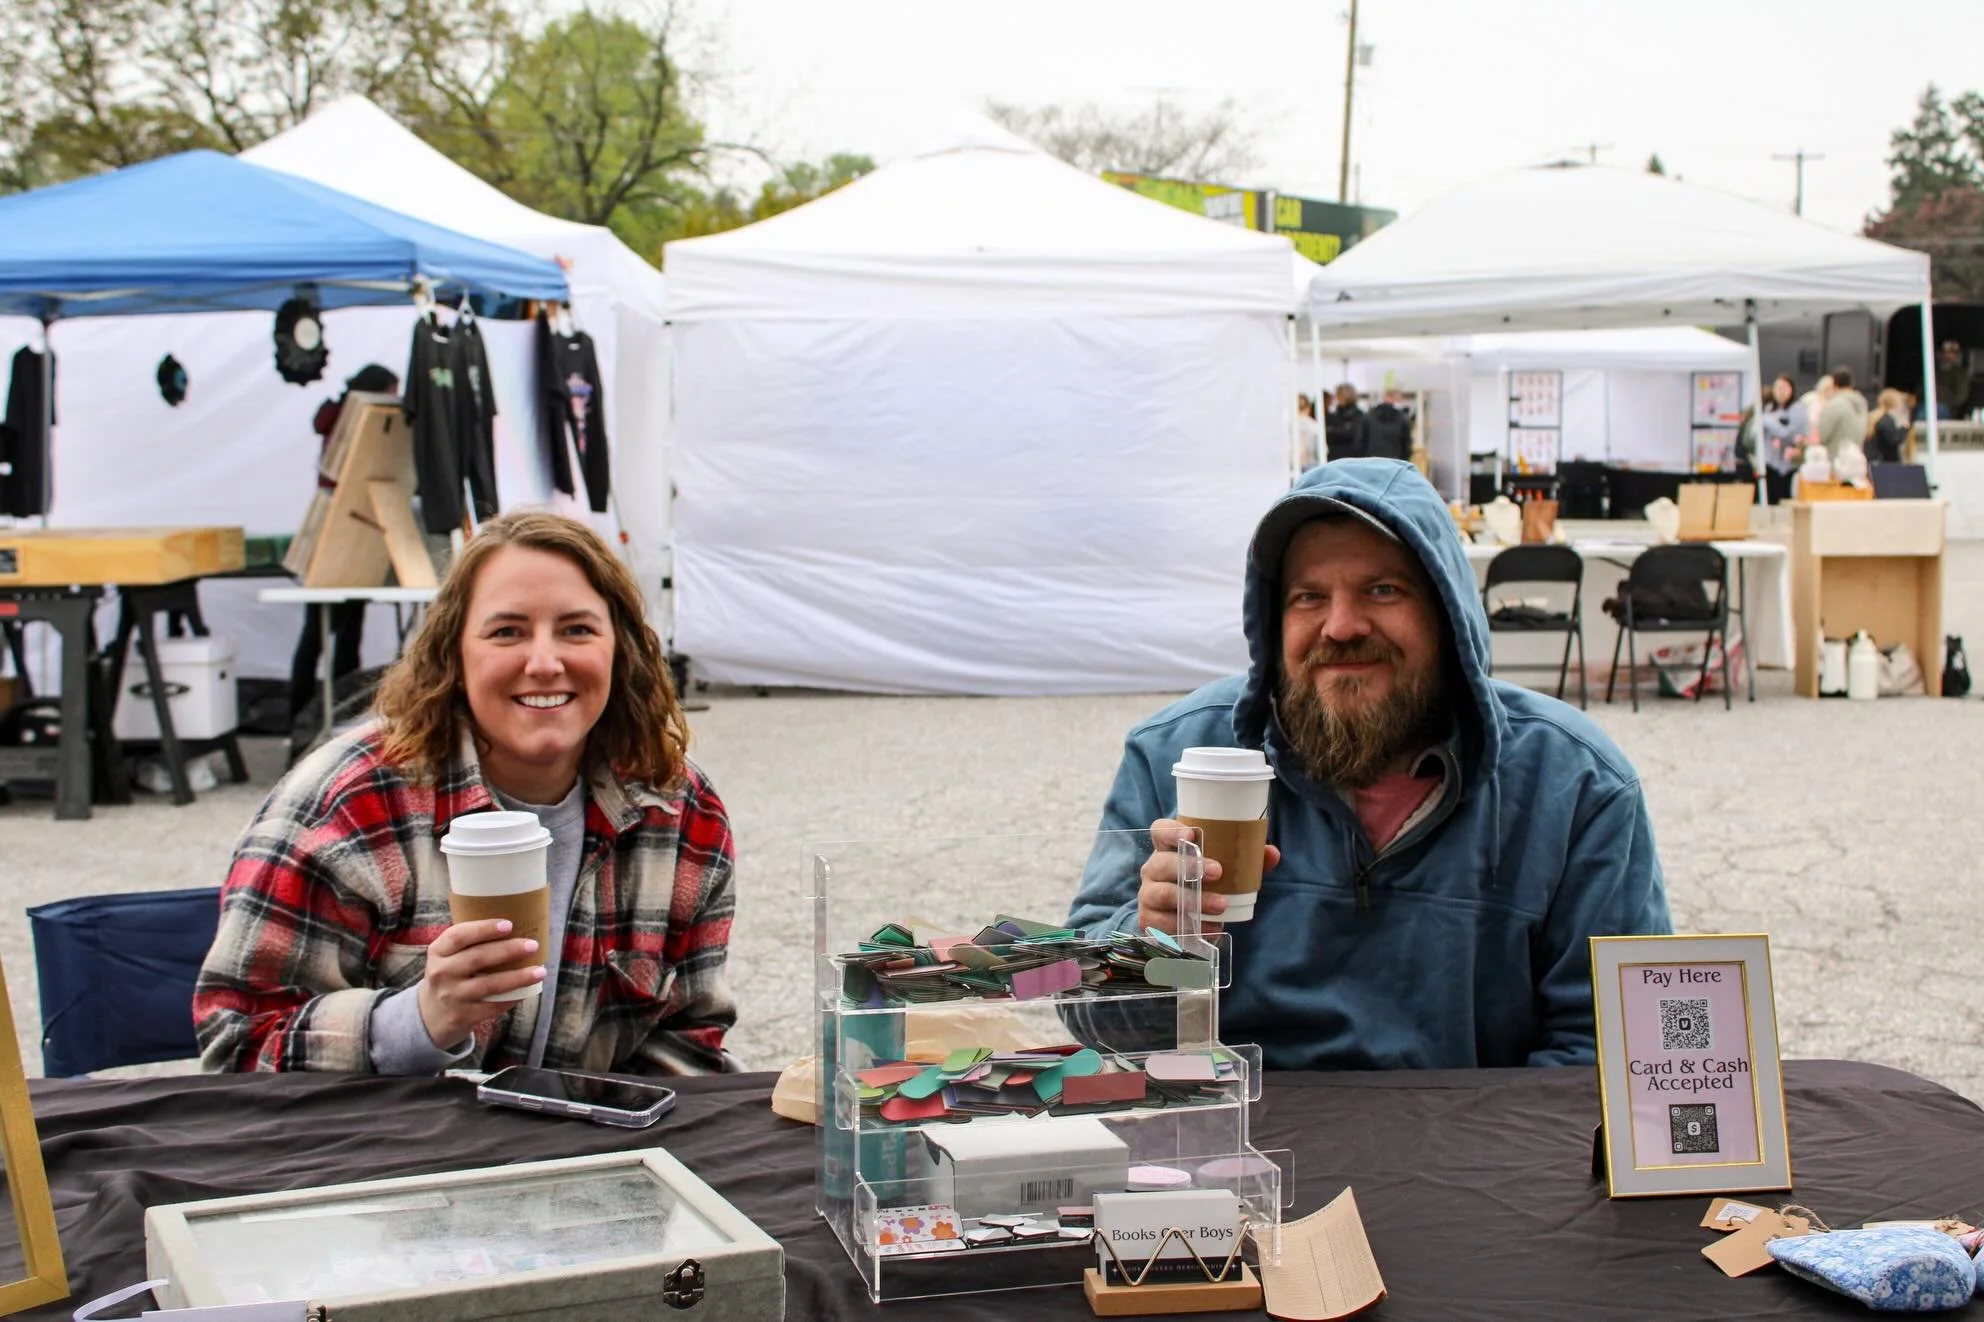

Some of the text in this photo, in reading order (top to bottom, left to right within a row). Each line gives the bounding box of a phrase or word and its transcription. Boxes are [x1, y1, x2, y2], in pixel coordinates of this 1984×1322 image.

[1642, 968, 1722, 988] Pay Here
[1629, 1057, 1749, 1076] Card & Cash
[1647, 1073, 1733, 1094] Accepted
[1112, 1228, 1156, 1241] Books
[1200, 1226, 1233, 1241] Boys
